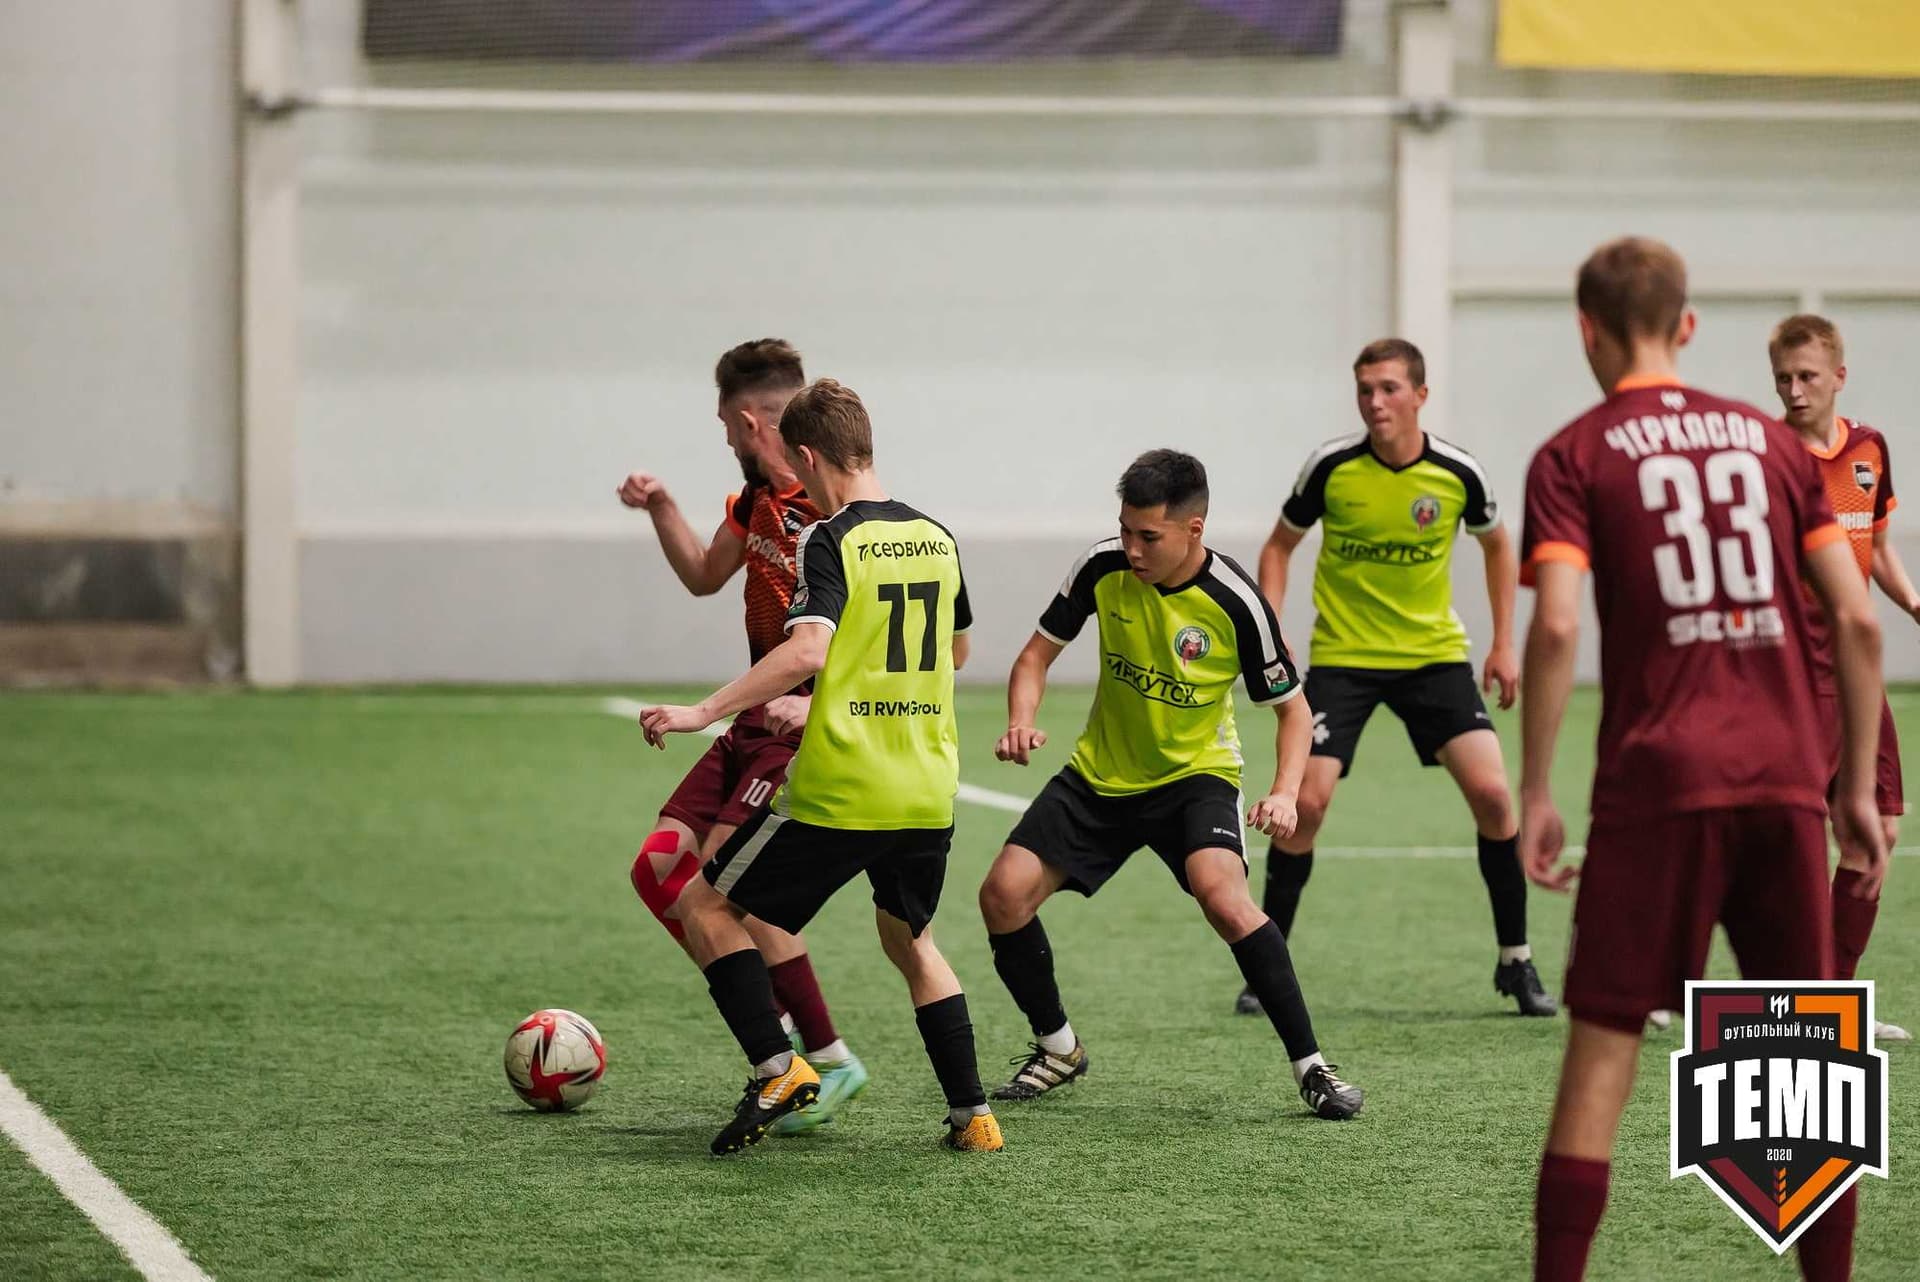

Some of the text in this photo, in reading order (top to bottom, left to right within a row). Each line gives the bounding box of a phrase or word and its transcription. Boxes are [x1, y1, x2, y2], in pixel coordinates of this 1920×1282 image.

[1604, 411, 1767, 460] ЧЕРКАСОВ
[1637, 449, 1774, 609] 33
[870, 540, 949, 560] сервико
[1107, 658, 1199, 705] ИРКУТСК
[875, 700, 941, 717] RVMGrou
[740, 778, 772, 807] 10
